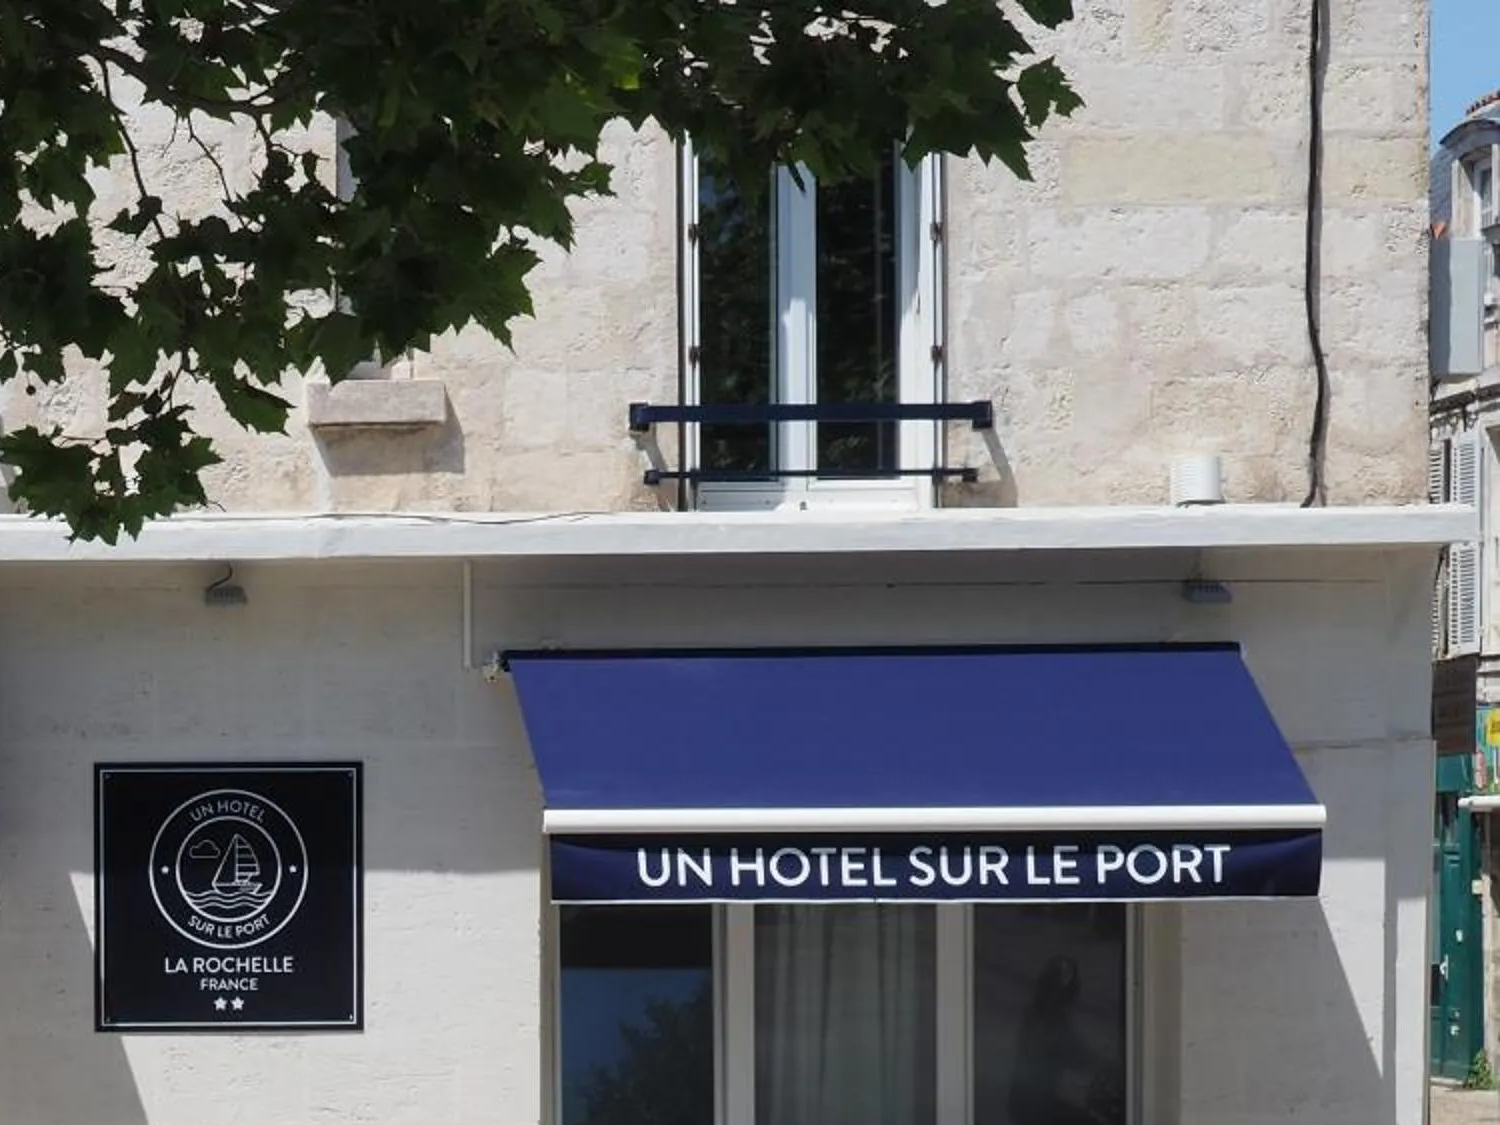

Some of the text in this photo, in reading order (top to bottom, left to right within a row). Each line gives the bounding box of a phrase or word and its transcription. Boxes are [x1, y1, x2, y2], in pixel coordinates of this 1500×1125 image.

[189, 800, 266, 823] UN HOTEL
[636, 844, 1231, 888] UN HOTEL SUR LE PORT
[187, 913, 271, 938] SUR LE PORT
[164, 956, 294, 974] LA ROCHELLE
[200, 978, 259, 991] FRANCE
